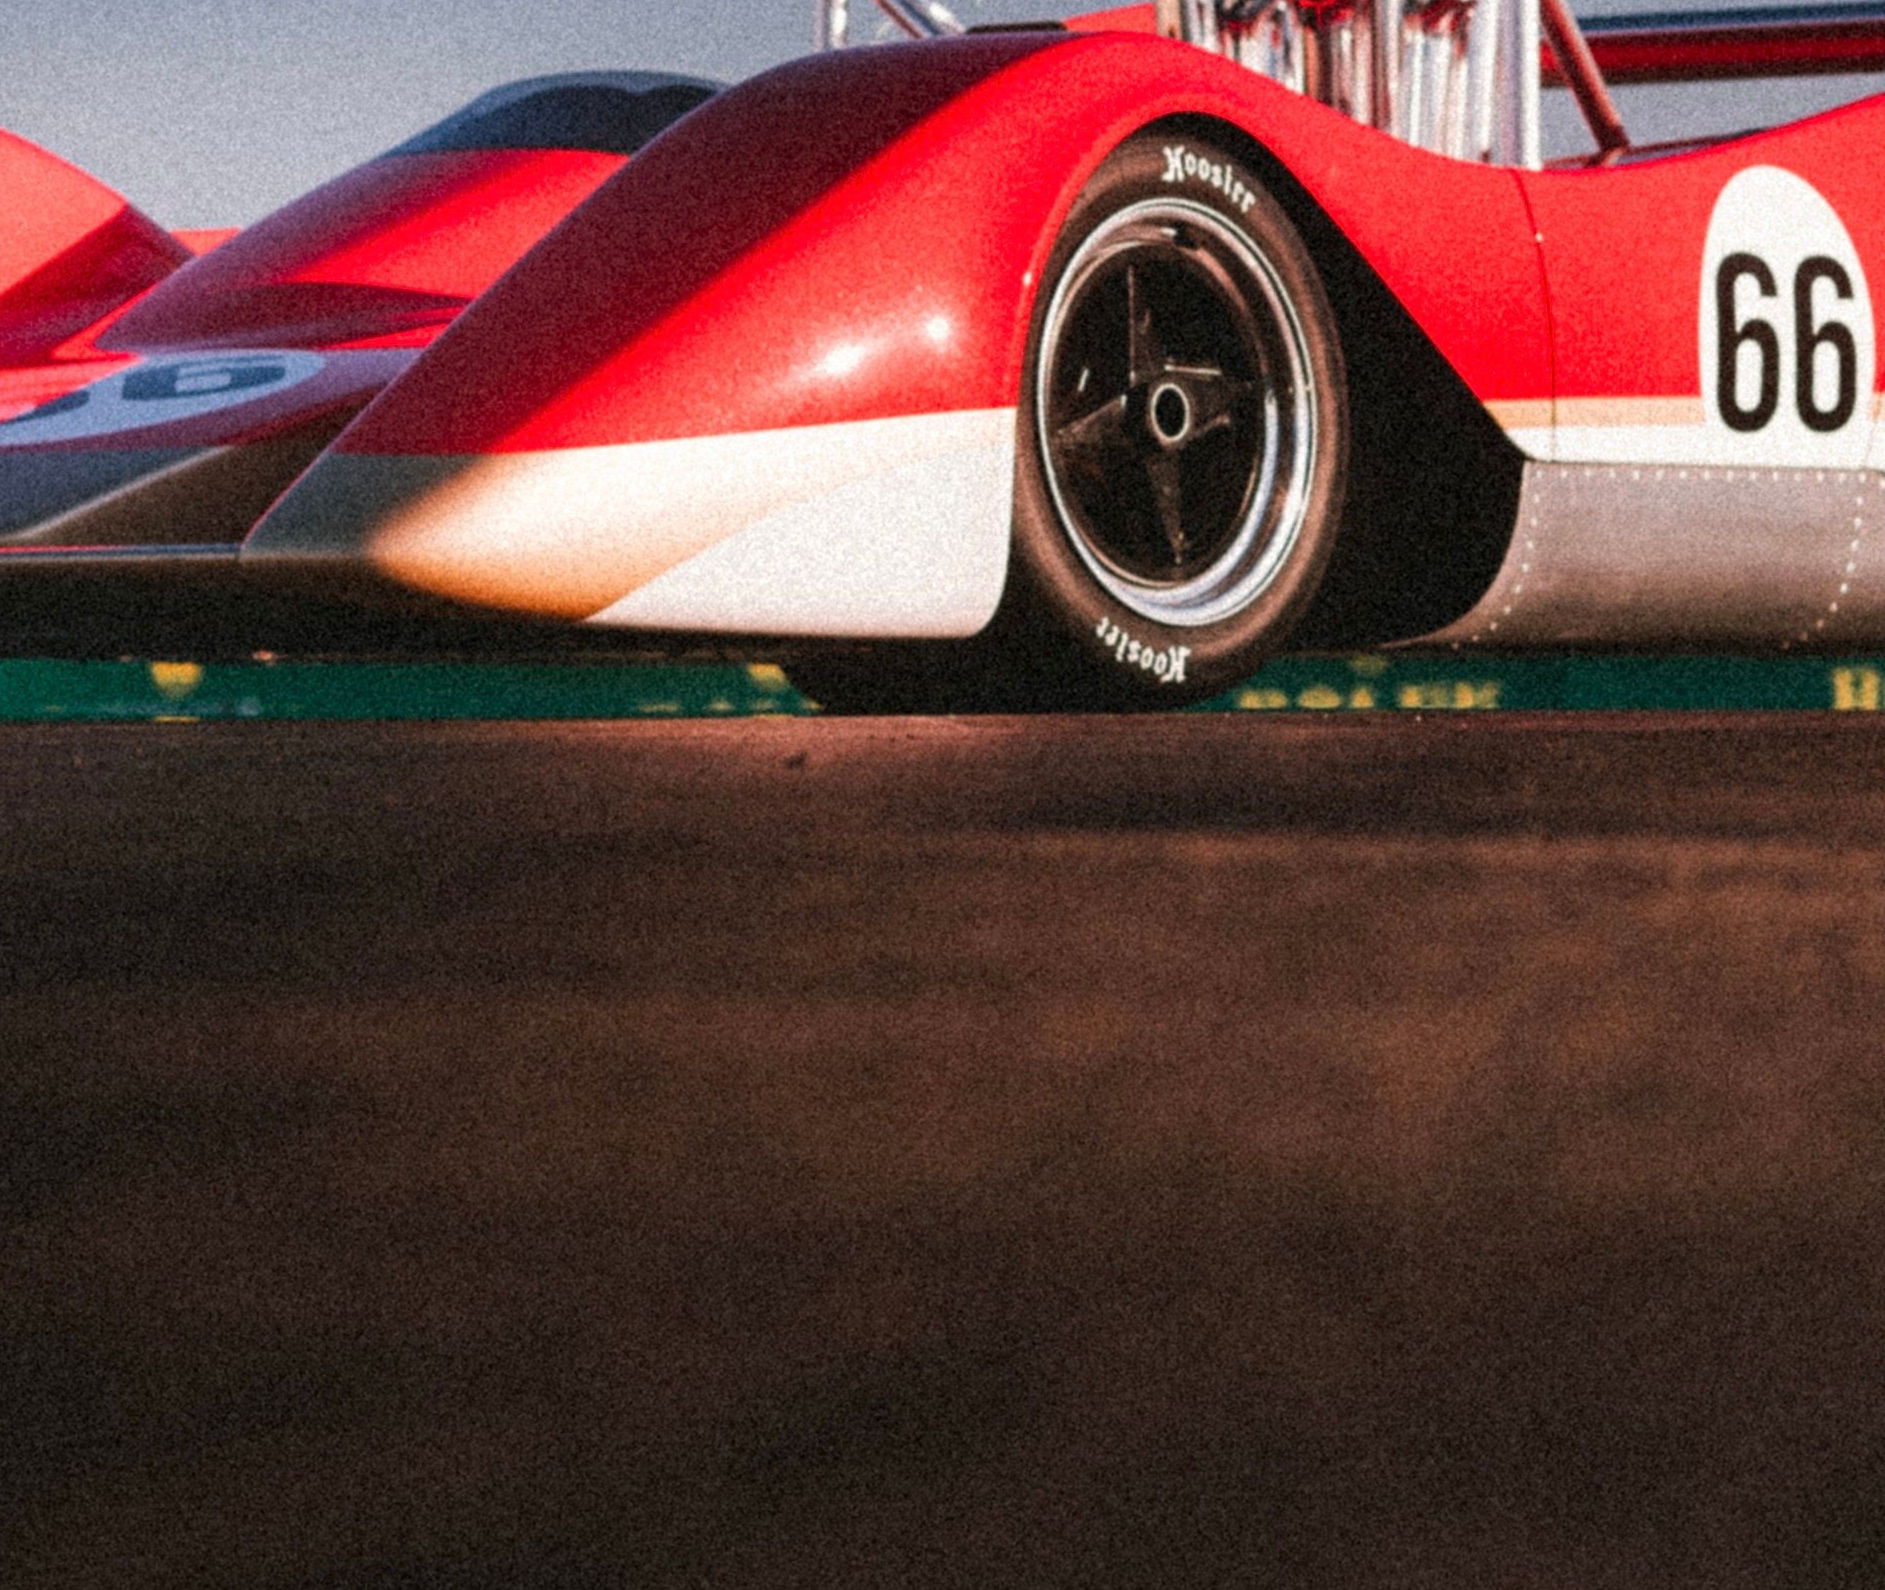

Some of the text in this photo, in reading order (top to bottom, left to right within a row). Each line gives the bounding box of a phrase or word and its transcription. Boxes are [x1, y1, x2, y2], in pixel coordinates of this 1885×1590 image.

[1161, 145, 1256, 213] Hoosier
[1716, 252, 1857, 432] 66
[1096, 616, 1192, 683] Hoosier
